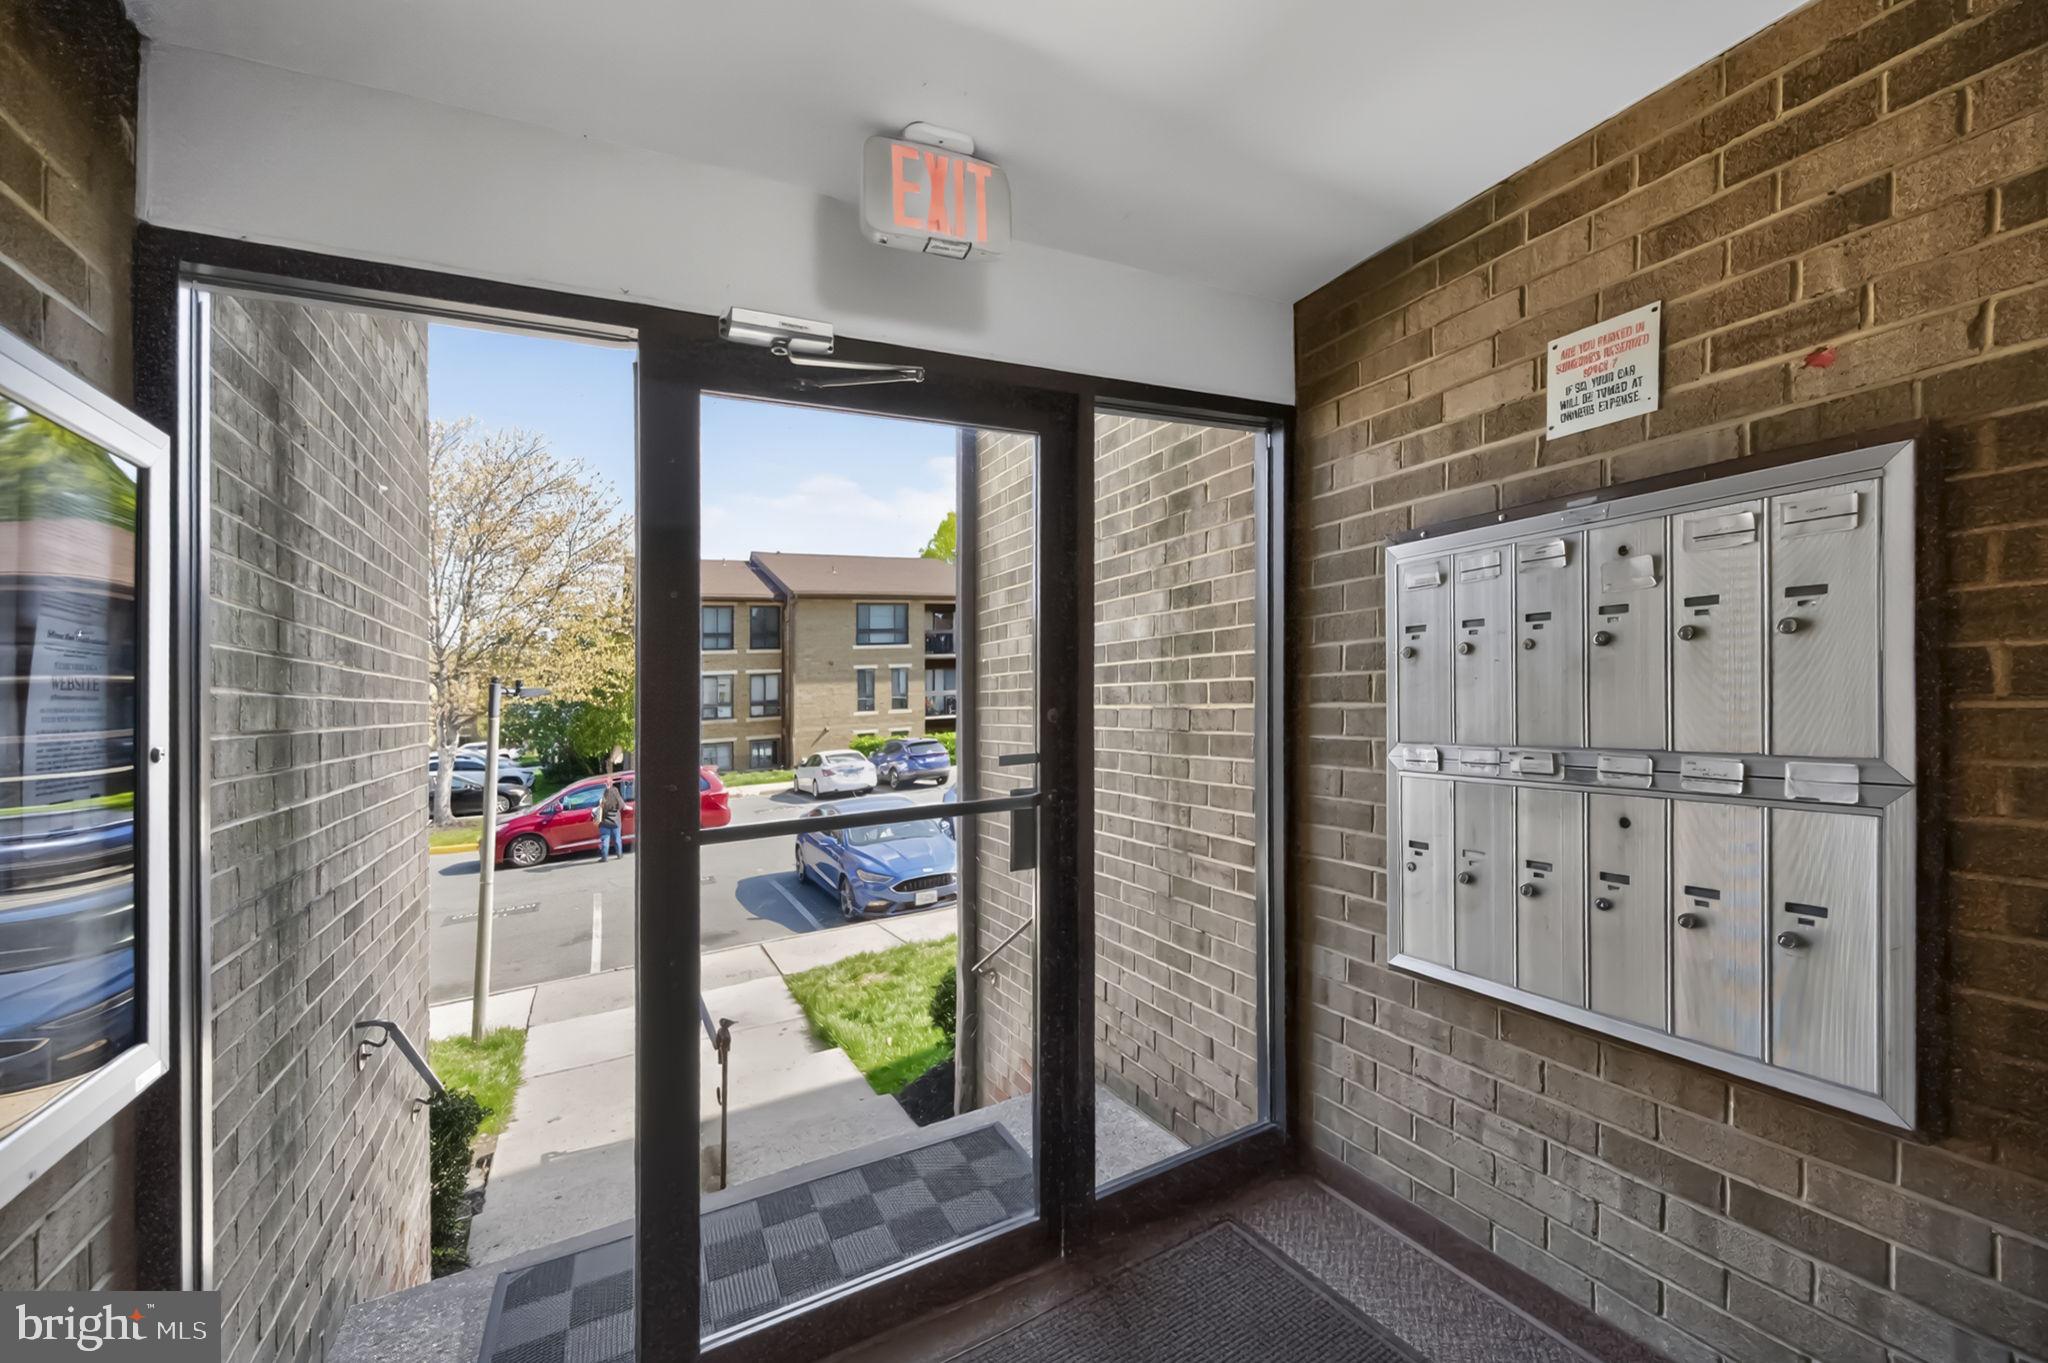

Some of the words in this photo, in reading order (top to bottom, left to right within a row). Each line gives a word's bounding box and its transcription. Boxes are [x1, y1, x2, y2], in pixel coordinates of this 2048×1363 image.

[891, 143, 993, 246] EXIT
[1579, 339, 1595, 353] YOU
[1598, 326, 1632, 347] PARKED
[1636, 322, 1645, 333] IN
[1604, 334, 1649, 358] RESERVED
[1560, 396, 1579, 411] WILL
[1596, 381, 1627, 398] TOWED
[1632, 376, 1643, 389] AT
[1565, 385, 1573, 396] IF
[1575, 381, 1587, 393] SO
[1591, 372, 1614, 388] YOUR
[1618, 365, 1635, 379] CAR
[51, 675, 100, 692] WEBSITE
